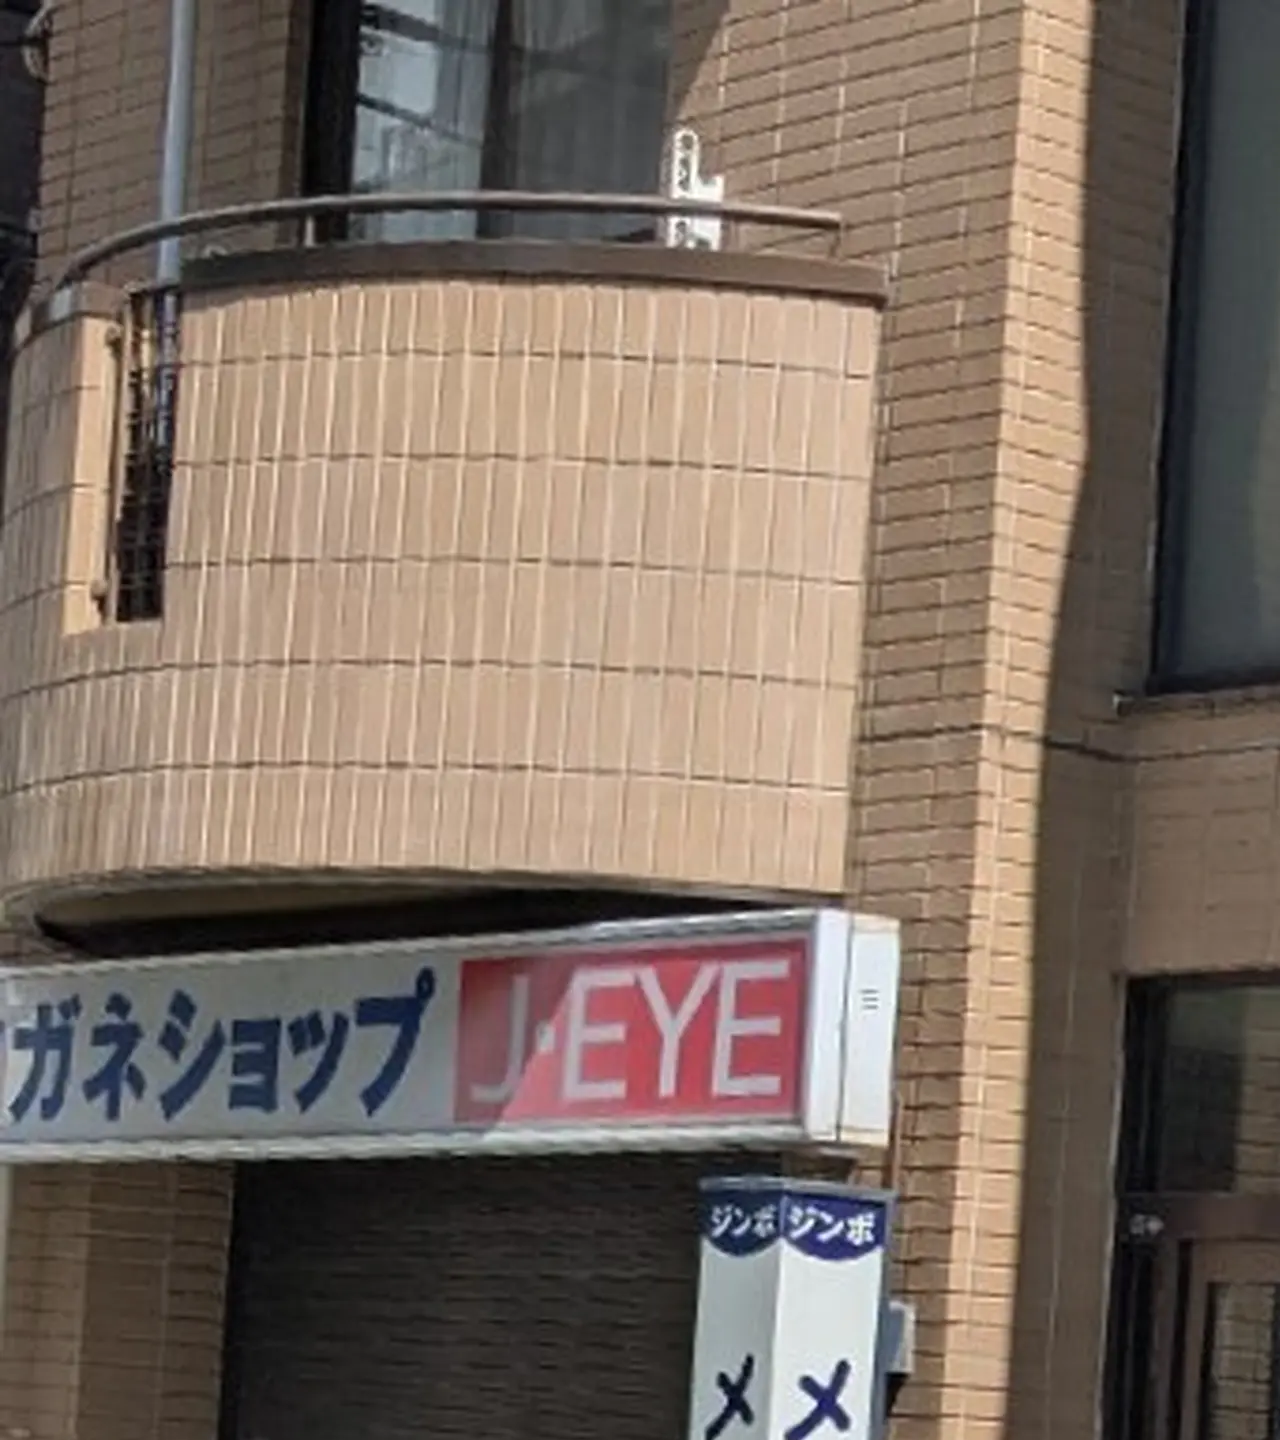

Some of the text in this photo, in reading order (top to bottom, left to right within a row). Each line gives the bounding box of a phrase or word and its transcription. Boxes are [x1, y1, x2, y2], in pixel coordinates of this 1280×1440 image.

[0, 966, 437, 1122] ガネショップ
[788, 1206, 876, 1246] ジンボ
